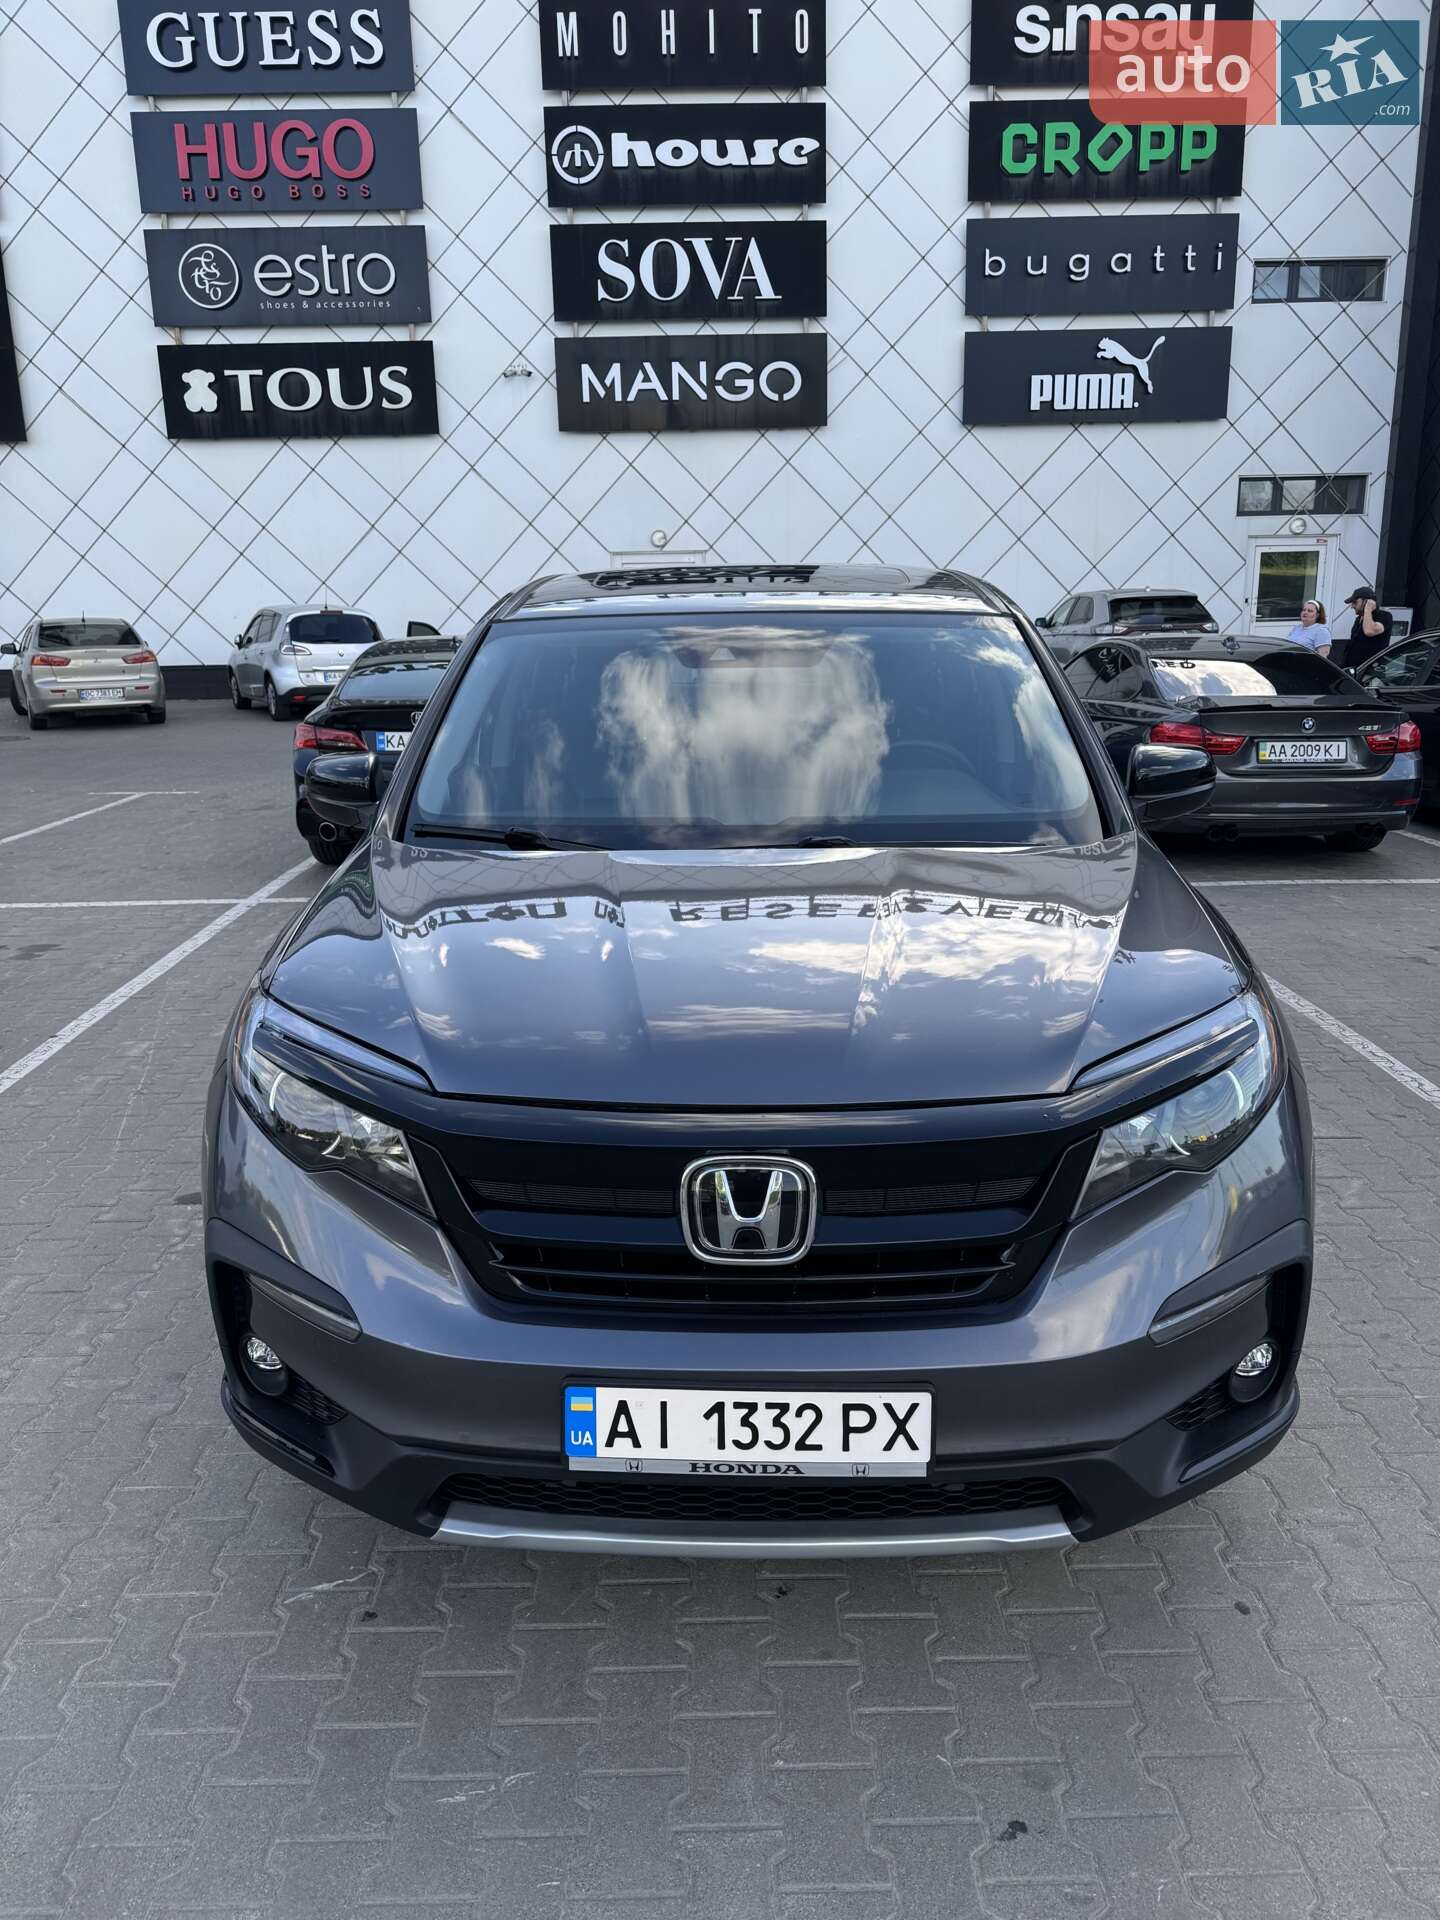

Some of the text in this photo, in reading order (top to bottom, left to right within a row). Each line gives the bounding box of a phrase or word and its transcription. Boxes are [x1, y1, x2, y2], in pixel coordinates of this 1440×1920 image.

[145, 9, 385, 68] GUESS
[556, 9, 810, 57] MOHITO
[174, 118, 374, 180] HUGO
[611, 132, 820, 168] house
[1001, 121, 1218, 175] CROPP
[182, 183, 370, 200] HUGO BOSS
[253, 244, 396, 297] estro
[597, 236, 782, 302] SOVA
[984, 242, 1223, 281] bugatti
[302, 301, 309, 309] &
[316, 300, 391, 309] accessories
[223, 365, 413, 413] TOUS
[580, 360, 803, 403] MANGO
[386, 735, 406, 749] KA
[1268, 744, 1340, 758] AA 2009 KI
[571, 1432, 593, 1446] UA
[604, 1400, 920, 1452] AI 1332 PX
[688, 1462, 806, 1475] HONDA
